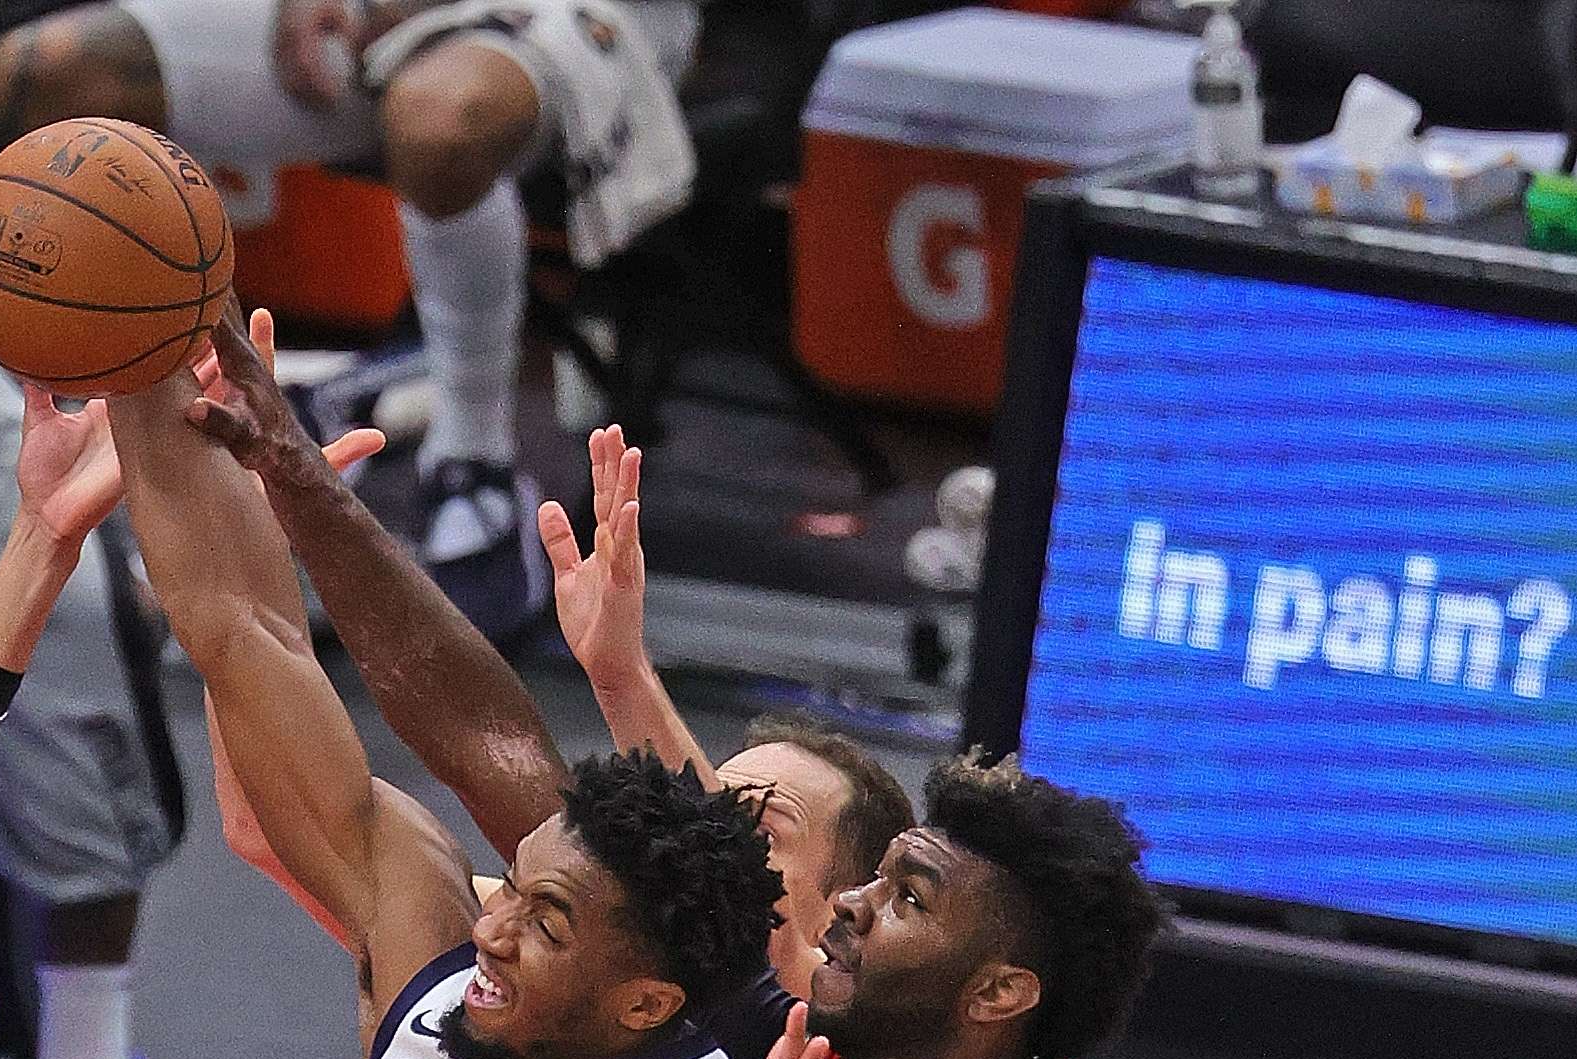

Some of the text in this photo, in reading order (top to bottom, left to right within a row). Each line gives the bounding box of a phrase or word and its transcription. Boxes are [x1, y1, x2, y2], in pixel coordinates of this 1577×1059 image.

[886, 184, 991, 329] G
[1118, 519, 1574, 699] In pain?
